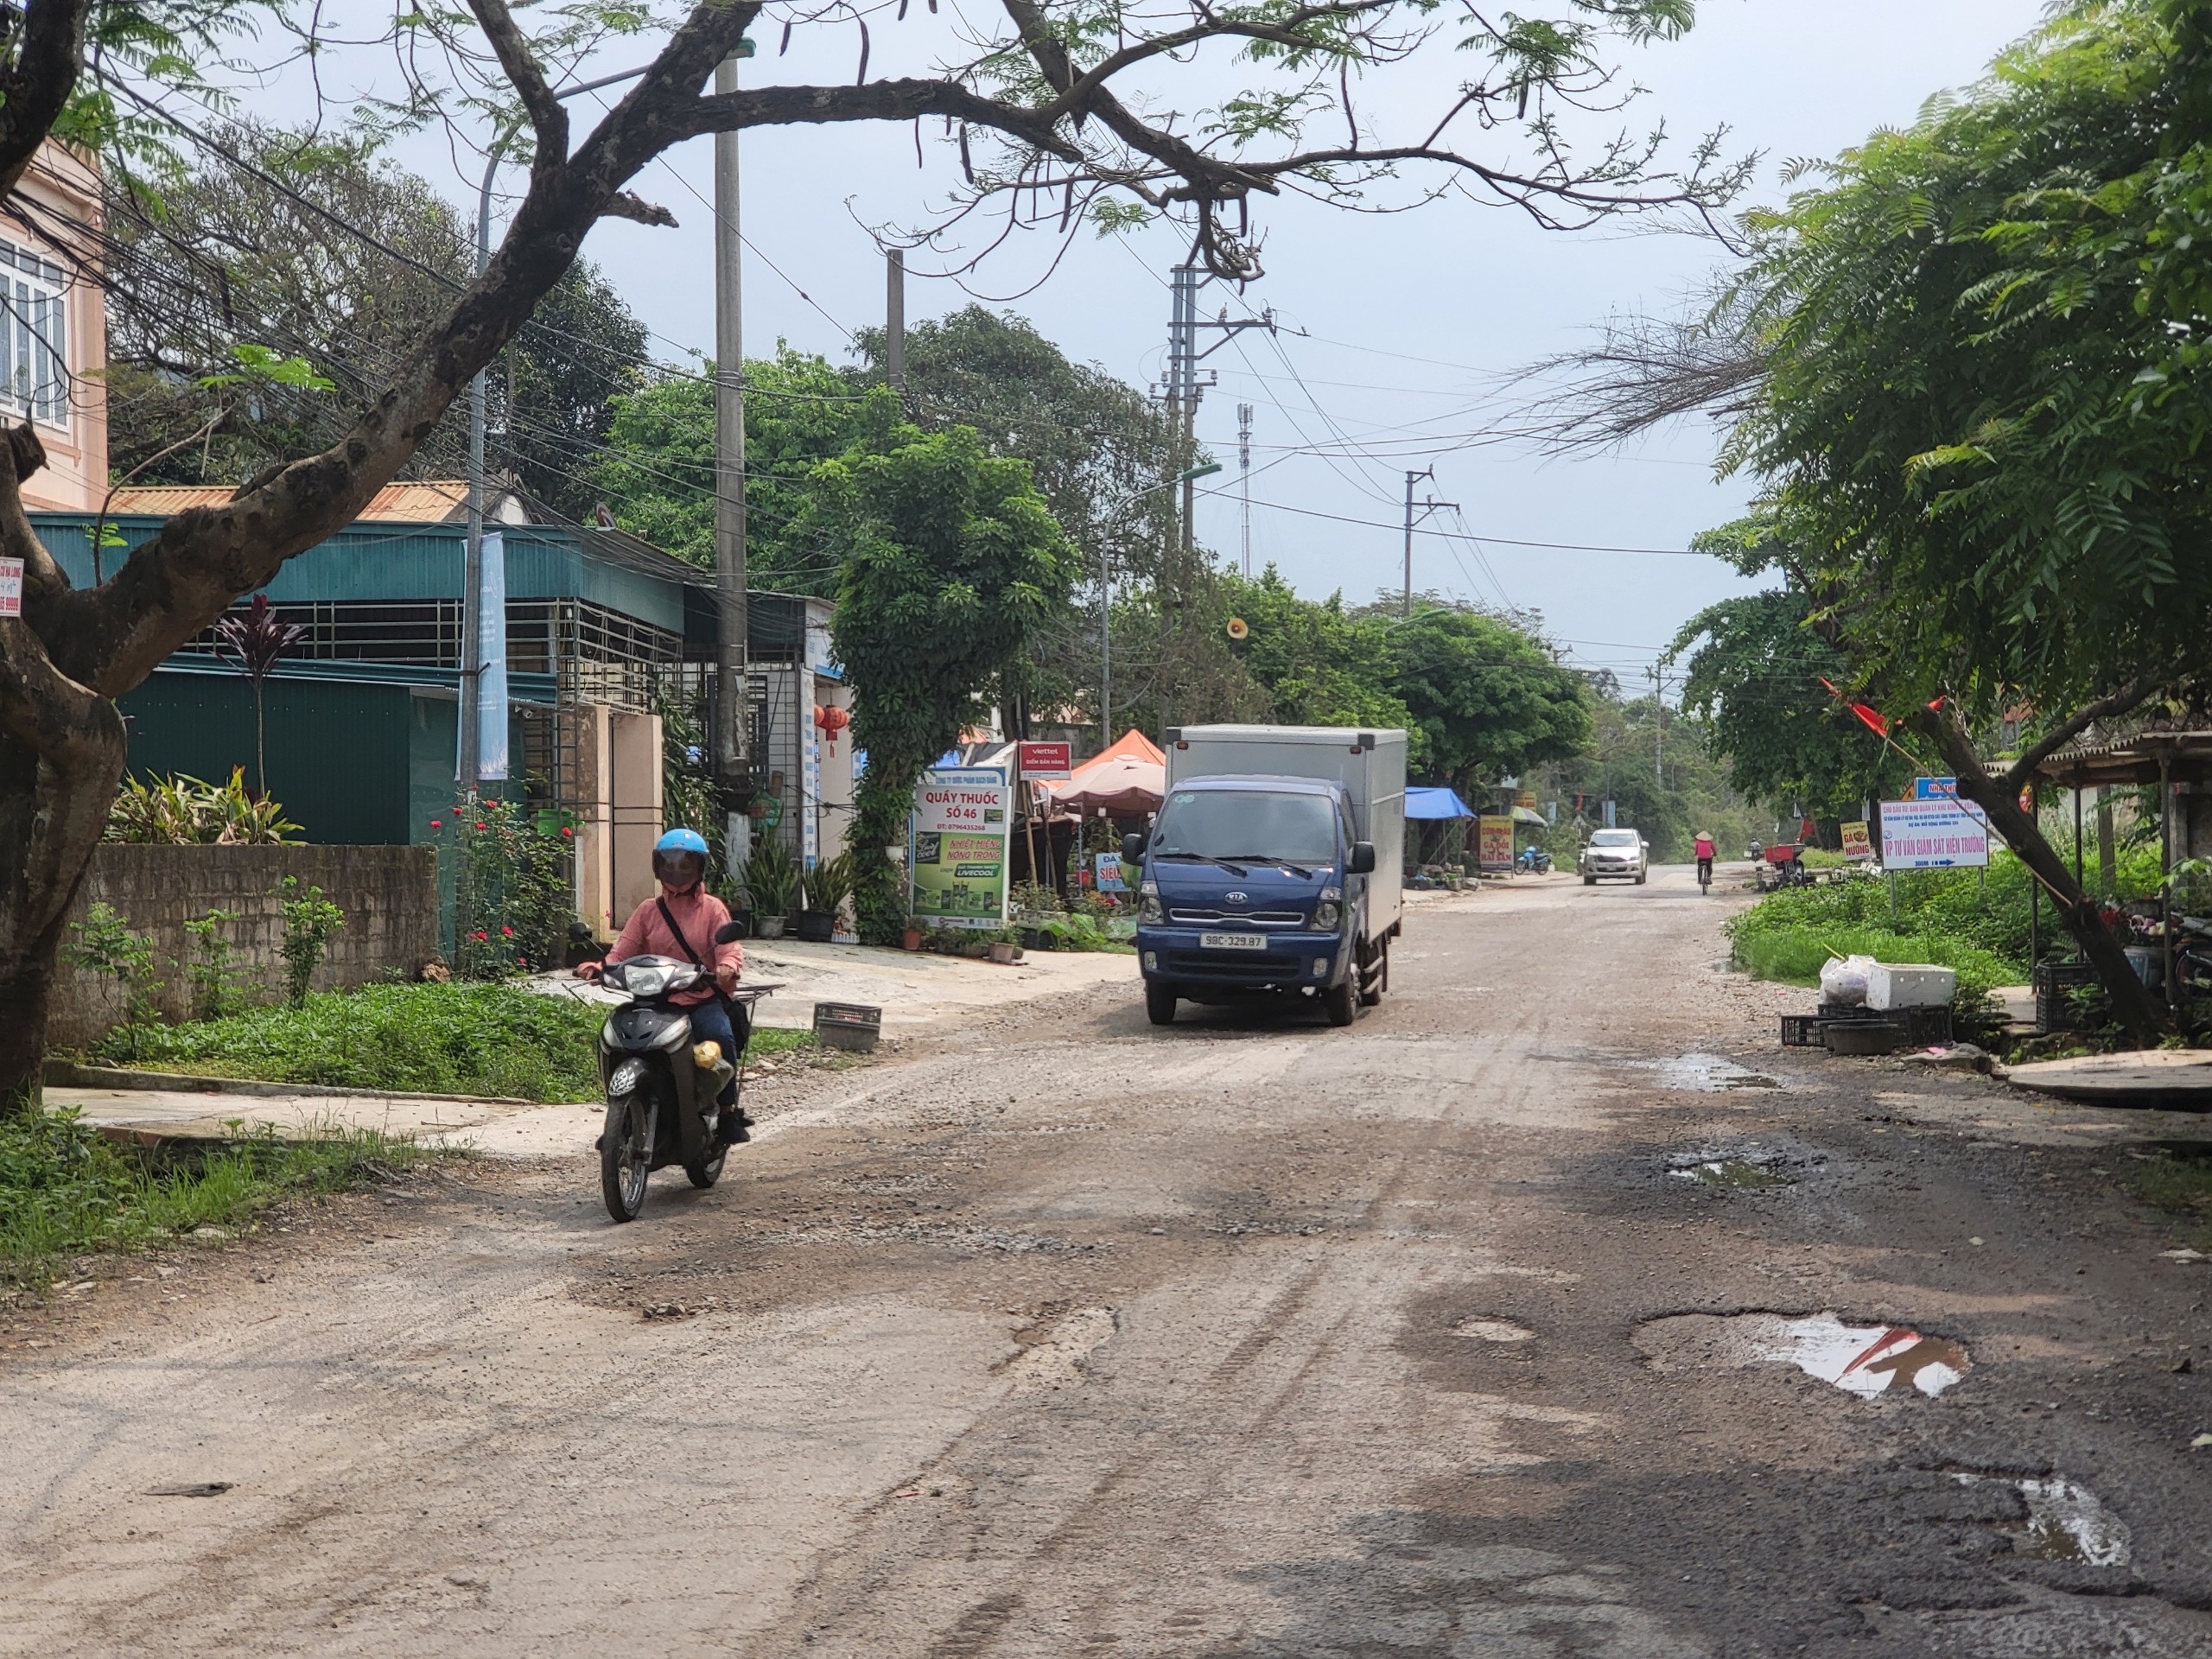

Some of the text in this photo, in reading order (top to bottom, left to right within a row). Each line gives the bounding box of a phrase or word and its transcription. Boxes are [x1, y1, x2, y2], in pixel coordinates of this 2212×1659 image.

[960, 790, 999, 805] THUỐC
[946, 804, 977, 819] SỐ 46
[1885, 840, 1893, 857] VP
[1933, 835, 1945, 855] SÁT
